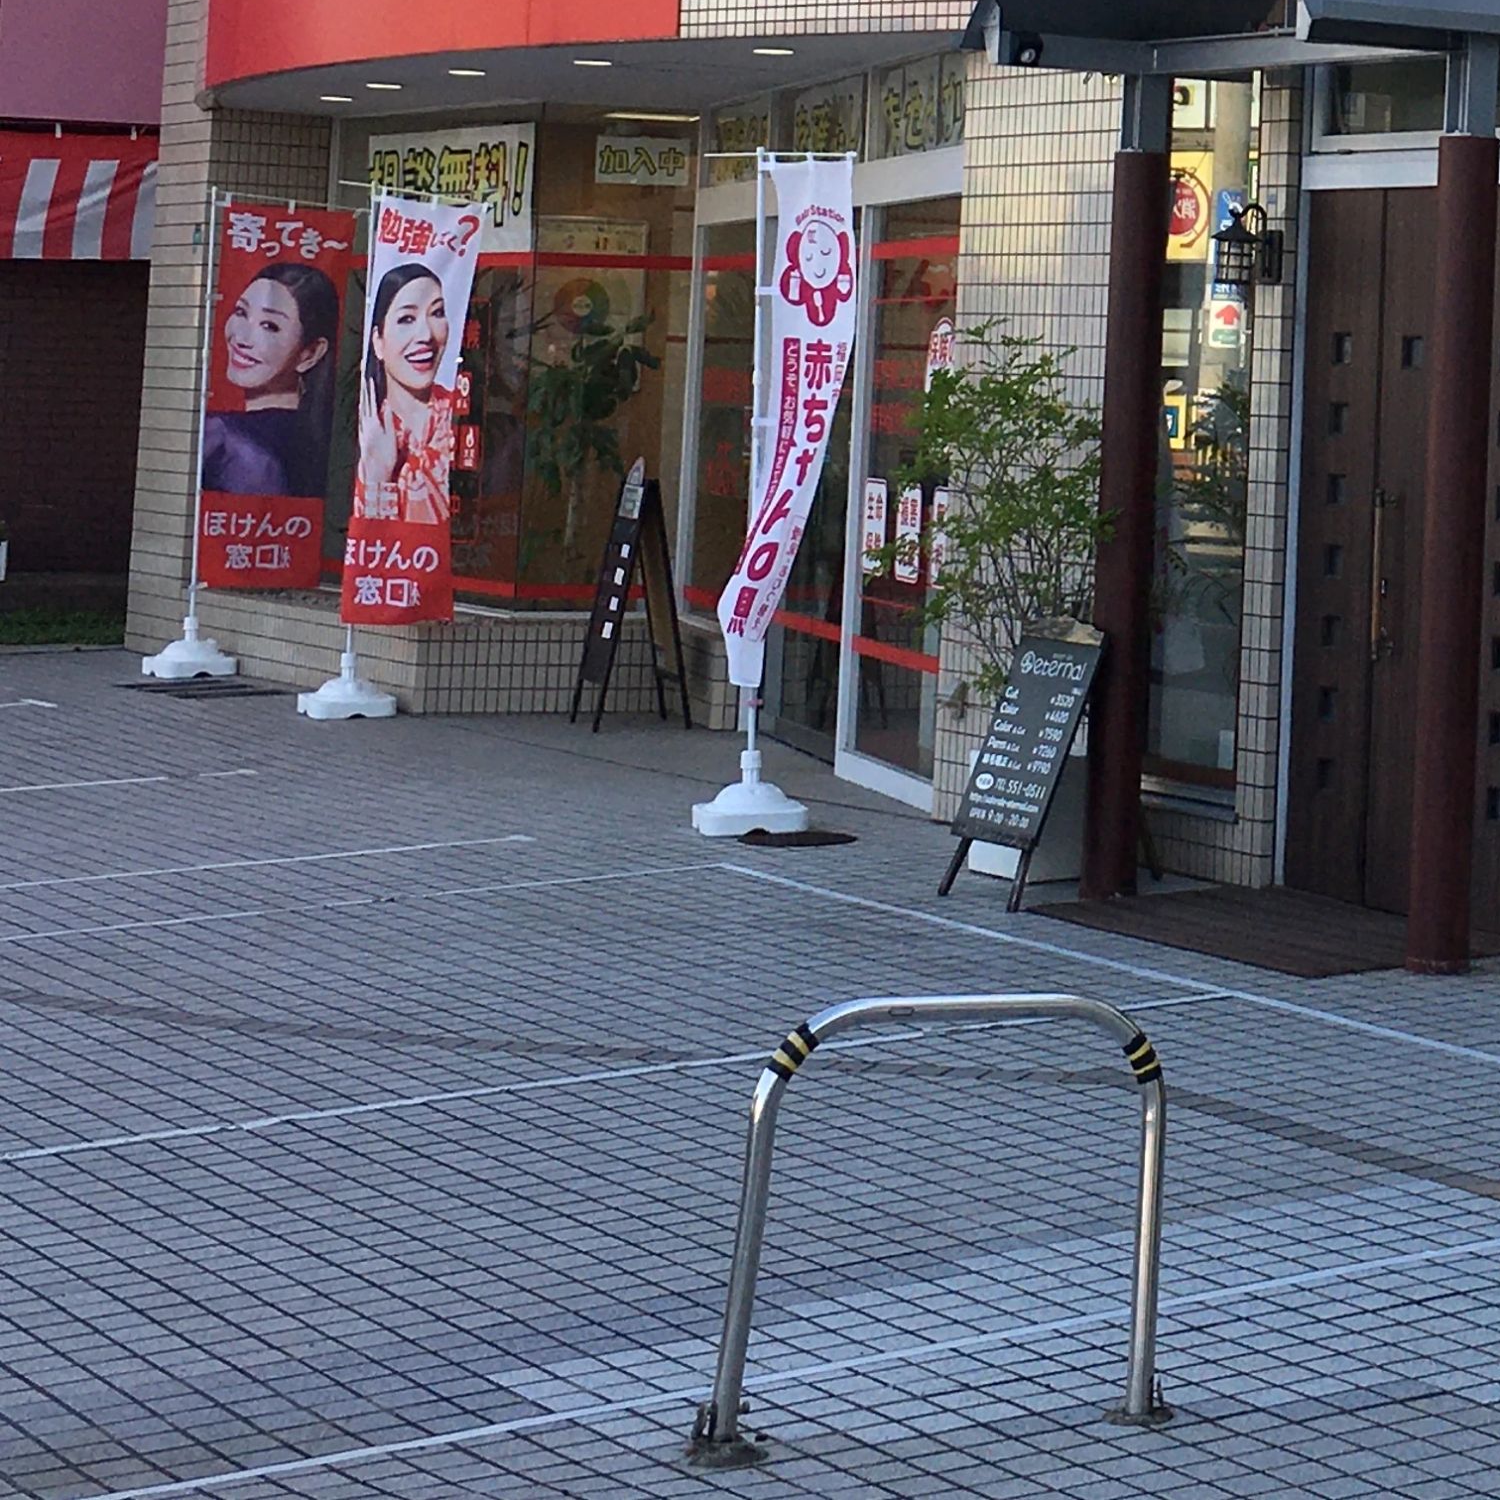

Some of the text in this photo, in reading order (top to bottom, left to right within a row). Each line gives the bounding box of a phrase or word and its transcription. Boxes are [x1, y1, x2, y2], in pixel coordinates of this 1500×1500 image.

[599, 145, 686, 177] 加入中
[204, 511, 313, 539] ほけんの
[224, 542, 281, 571] 窓口
[353, 574, 413, 608] 窓口
[1033, 656, 1087, 681] eternal
